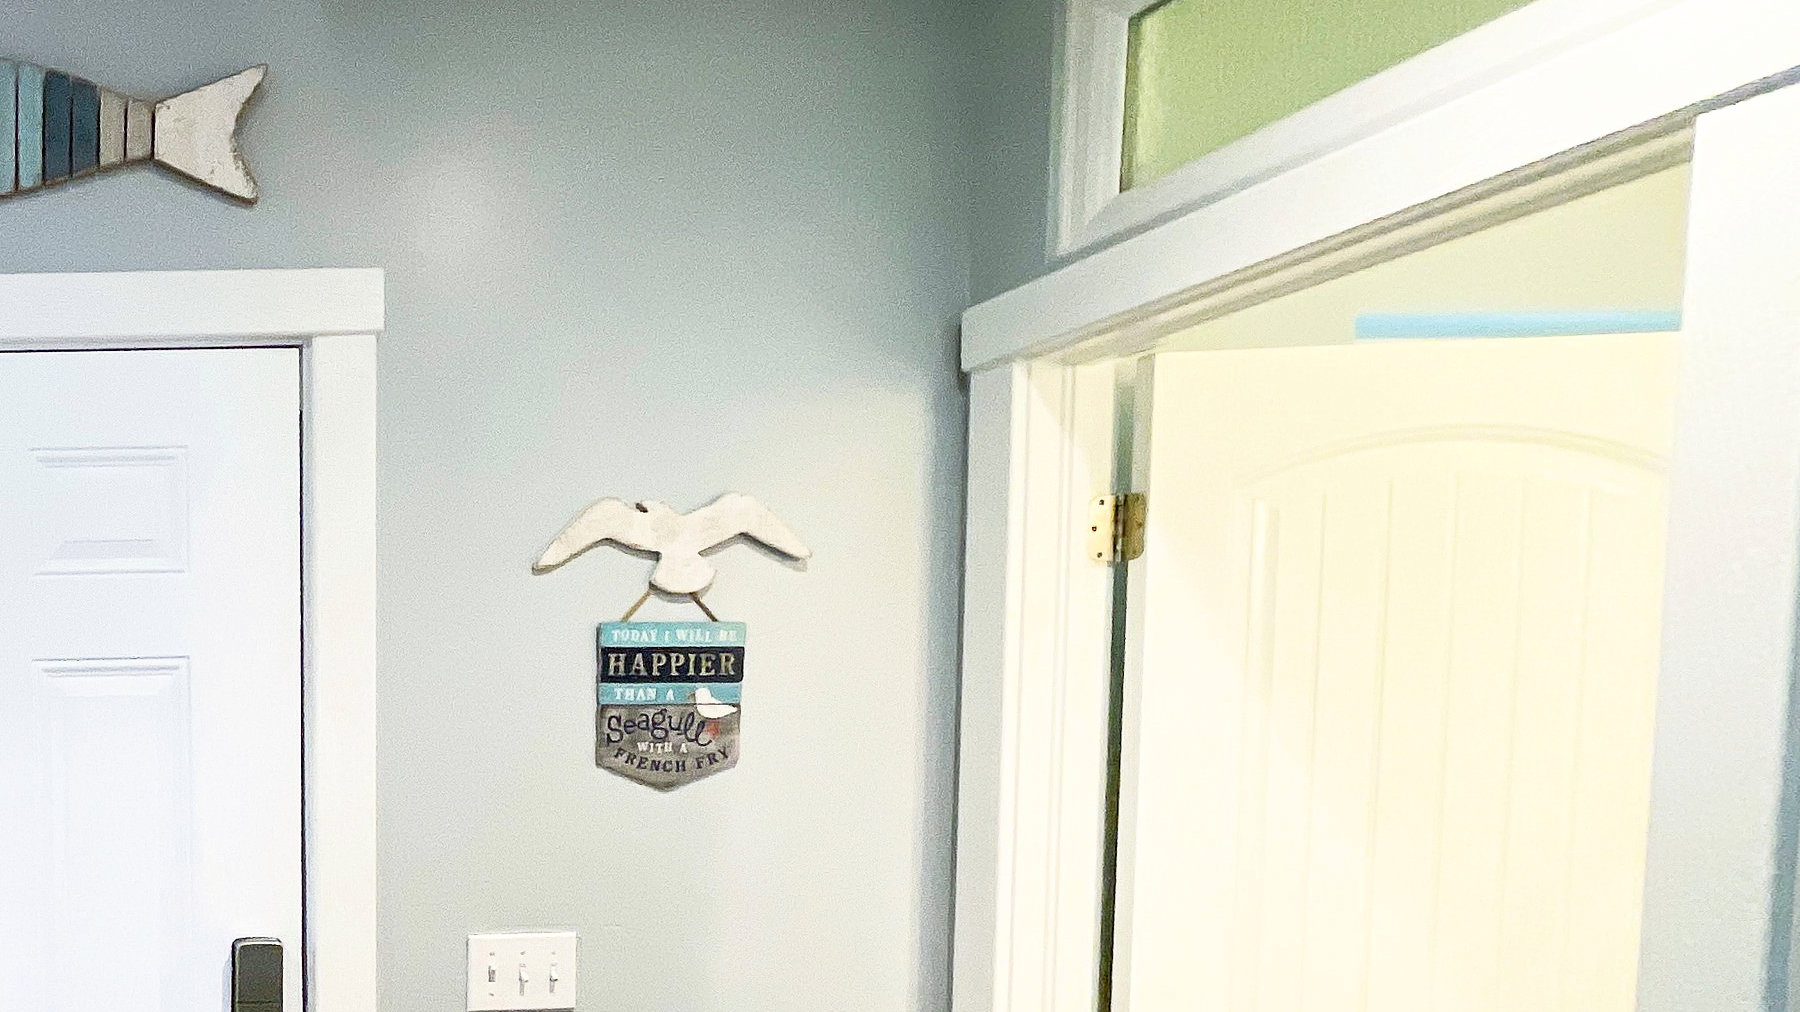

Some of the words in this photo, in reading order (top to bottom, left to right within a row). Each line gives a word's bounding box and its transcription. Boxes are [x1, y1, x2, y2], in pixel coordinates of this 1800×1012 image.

[612, 629, 656, 642] TODAY
[664, 630, 669, 642] I
[675, 629, 712, 642] WILL
[718, 629, 737, 642] BE
[608, 652, 736, 677] HAPPIER
[614, 687, 657, 701] THAN
[666, 688, 675, 701] A
[606, 708, 712, 747] Seagull
[637, 742, 673, 754] WITH
[680, 742, 688, 754] A
[614, 747, 686, 772] FRENCH
[696, 746, 729, 769] FRY
